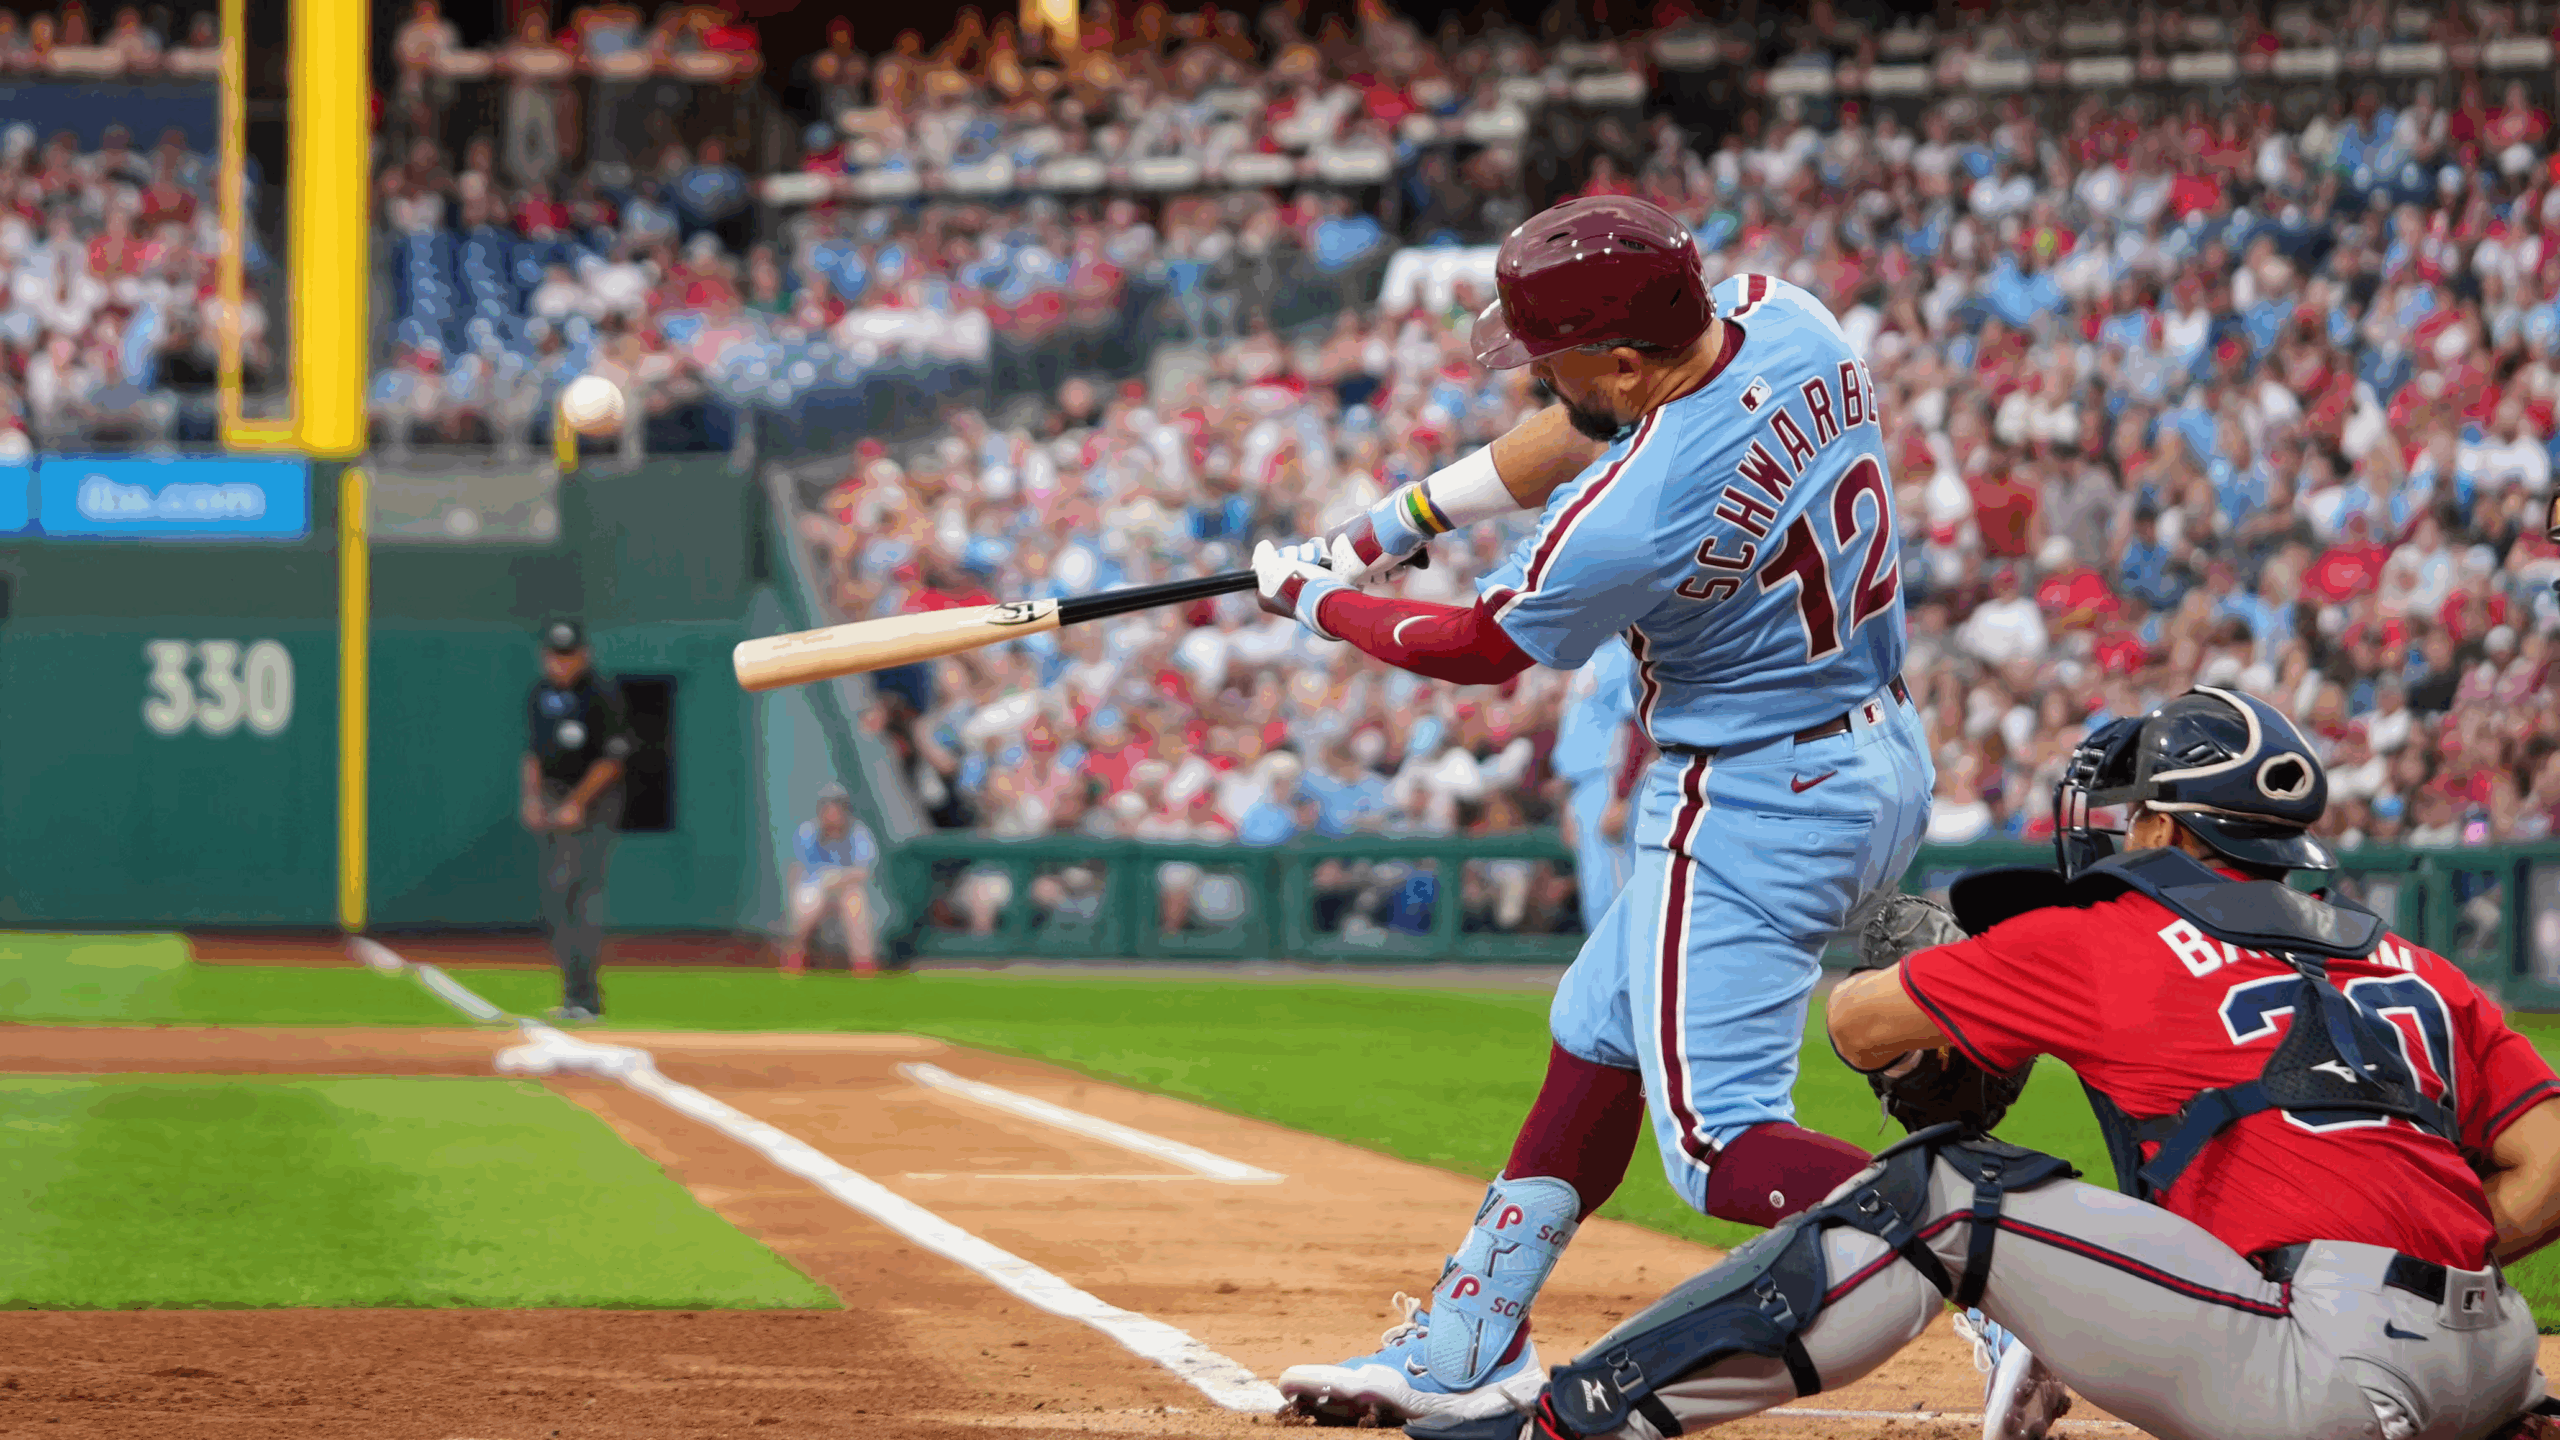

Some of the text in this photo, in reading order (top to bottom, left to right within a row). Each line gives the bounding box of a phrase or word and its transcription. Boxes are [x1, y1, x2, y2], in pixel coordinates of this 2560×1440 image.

[1756, 452, 1900, 664] 12
[144, 640, 293, 734] 330
[1536, 1224, 1571, 1249] SC
